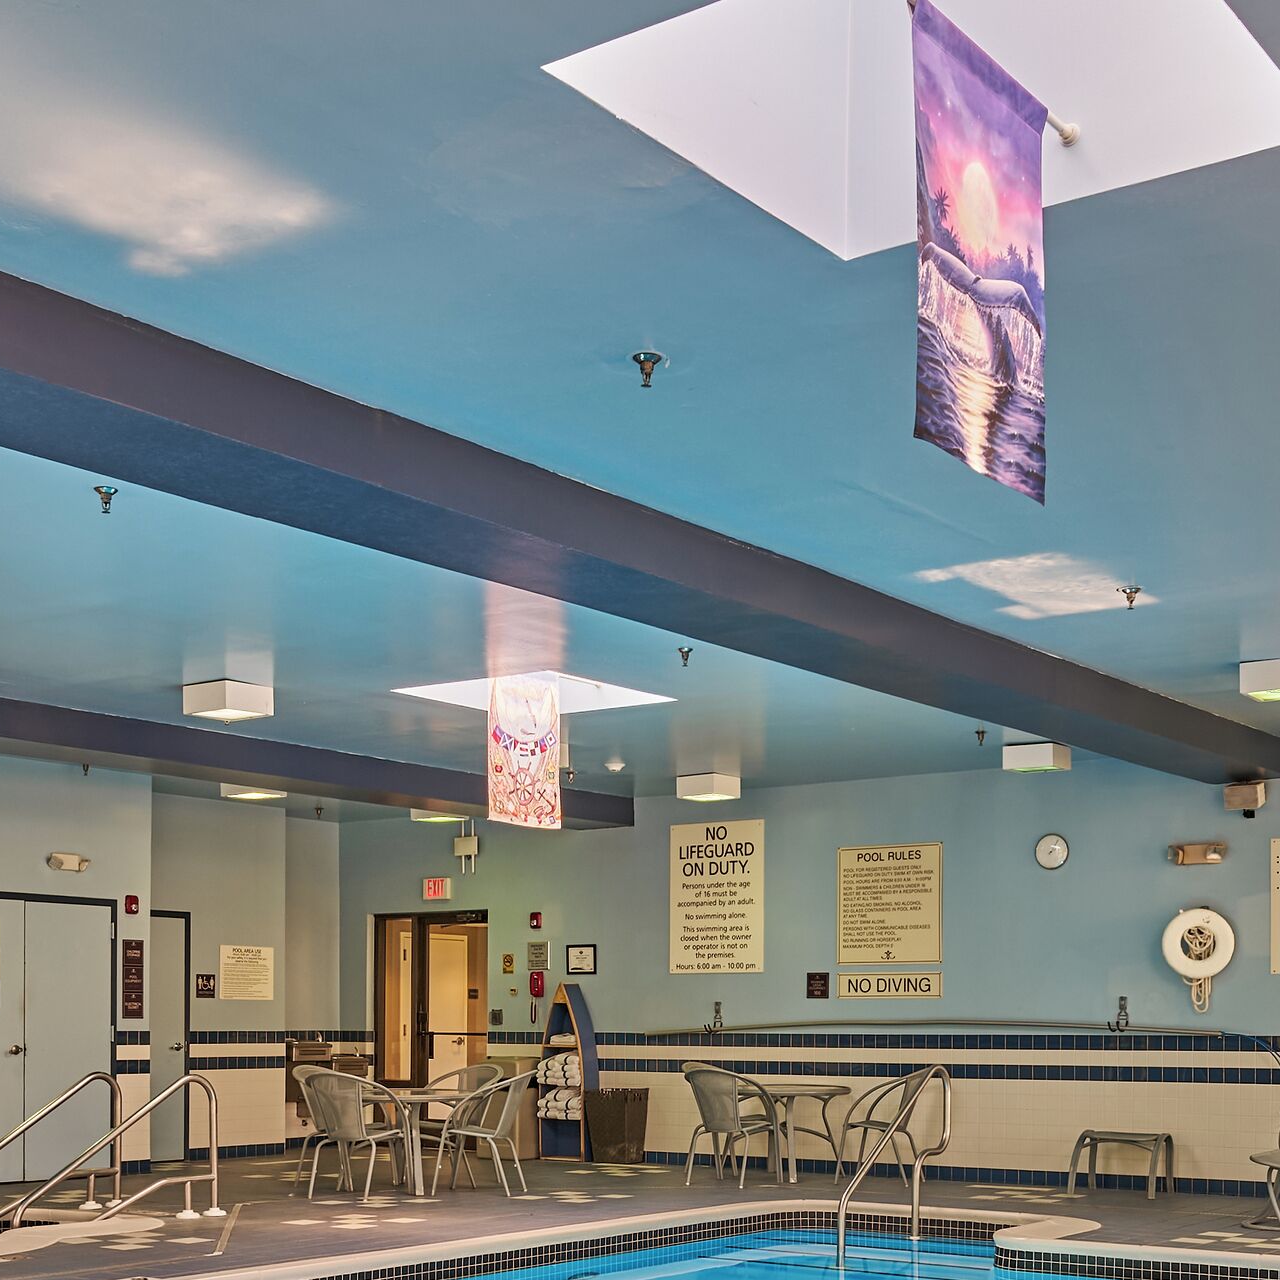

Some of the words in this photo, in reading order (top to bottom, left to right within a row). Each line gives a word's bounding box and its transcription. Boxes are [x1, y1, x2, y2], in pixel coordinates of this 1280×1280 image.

[706, 825, 727, 841] NO
[679, 841, 754, 860] LIFEGUARD
[857, 852, 885, 863] POOL
[888, 849, 921, 861] RULES
[682, 862, 704, 877] ON
[709, 859, 749, 876] DUTY.
[427, 879, 444, 897] EXIT
[682, 882, 705, 890] Persons
[706, 881, 726, 889] under
[726, 880, 738, 888] the
[738, 881, 750, 889] age
[704, 890, 711, 898] 16
[729, 889, 737, 897] be
[677, 899, 717, 908] accompanied
[718, 898, 726, 907] by
[695, 912, 727, 921] swimming
[696, 925, 728, 934] swimming
[680, 934, 700, 942] closed
[719, 933, 730, 941] the
[691, 943, 719, 951] operator
[695, 951, 706, 959] the
[696, 962, 710, 970] 6:00
[848, 978, 871, 993] NO
[876, 977, 931, 992] DIVING
